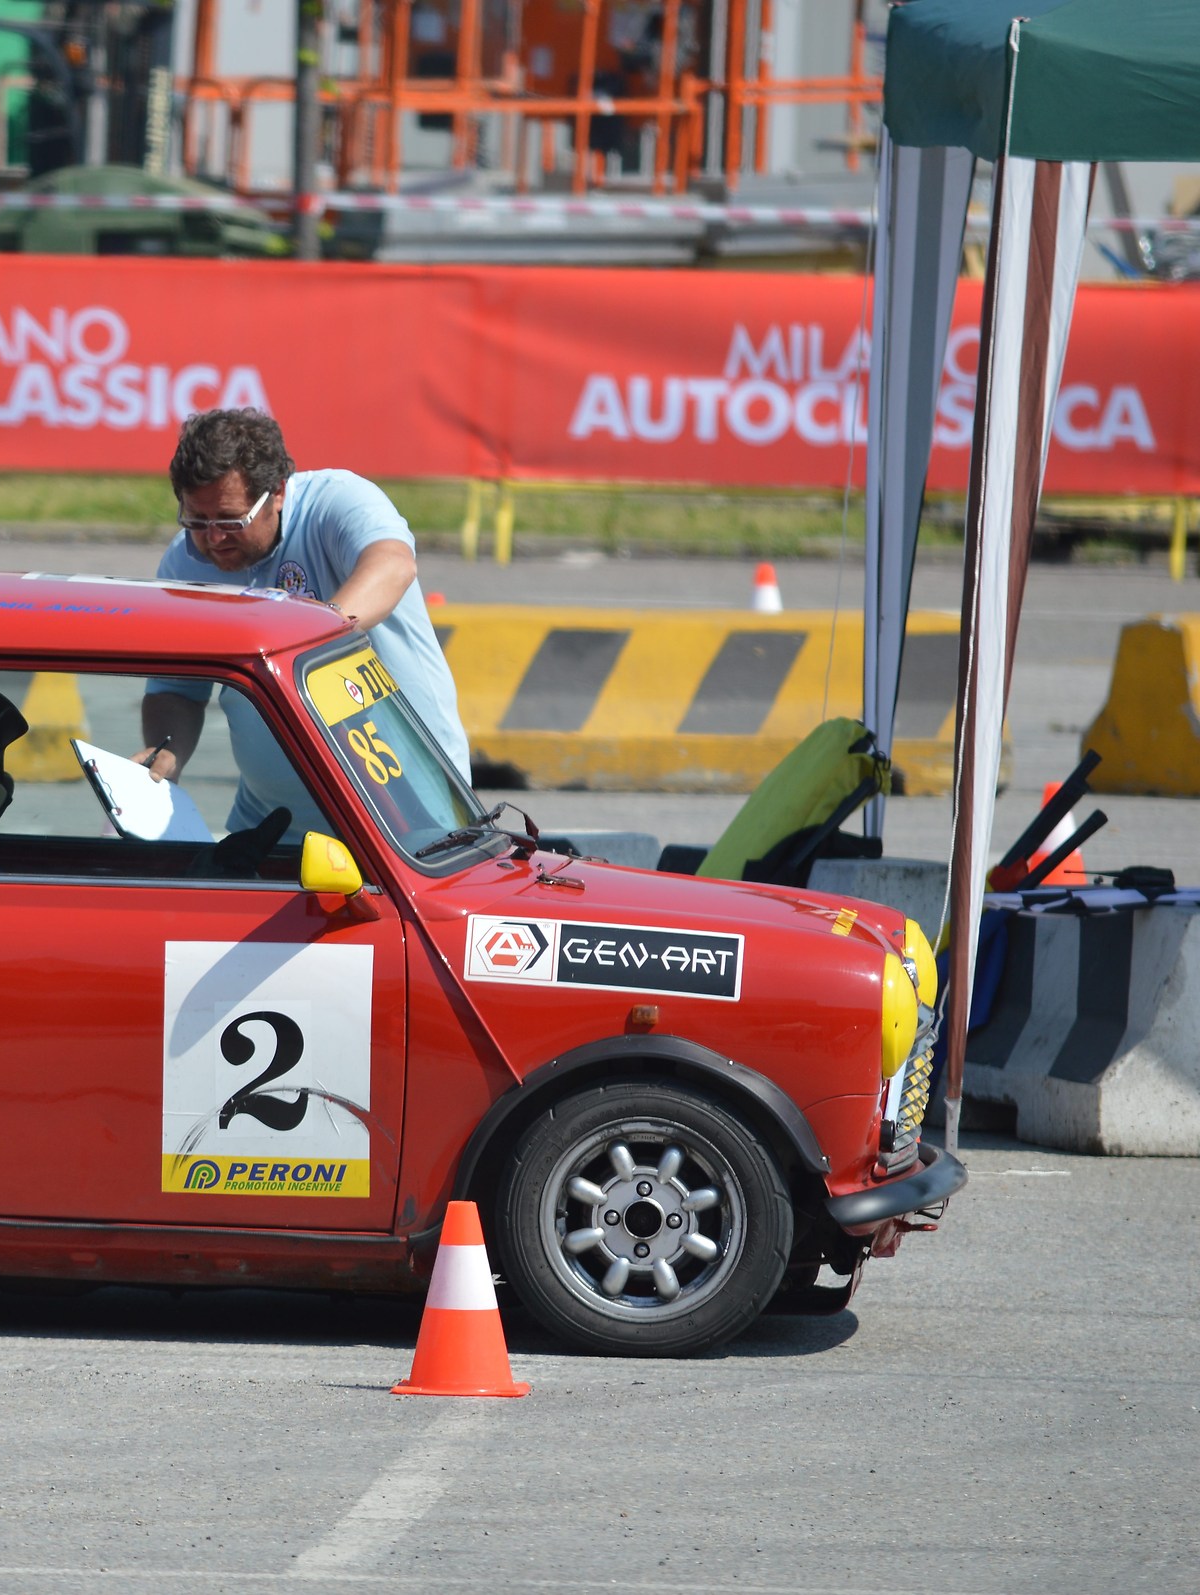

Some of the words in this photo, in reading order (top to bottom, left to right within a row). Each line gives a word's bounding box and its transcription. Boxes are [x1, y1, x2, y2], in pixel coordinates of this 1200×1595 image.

[723, 323, 982, 384] MILAO
[347, 720, 402, 785] 85
[562, 937, 734, 976] GEN-ART
[218, 1010, 310, 1132] 2
[224, 1181, 286, 1191] PROMOTION
[287, 1182, 342, 1192] INCENTIVE
[226, 1162, 348, 1183] PERONI
